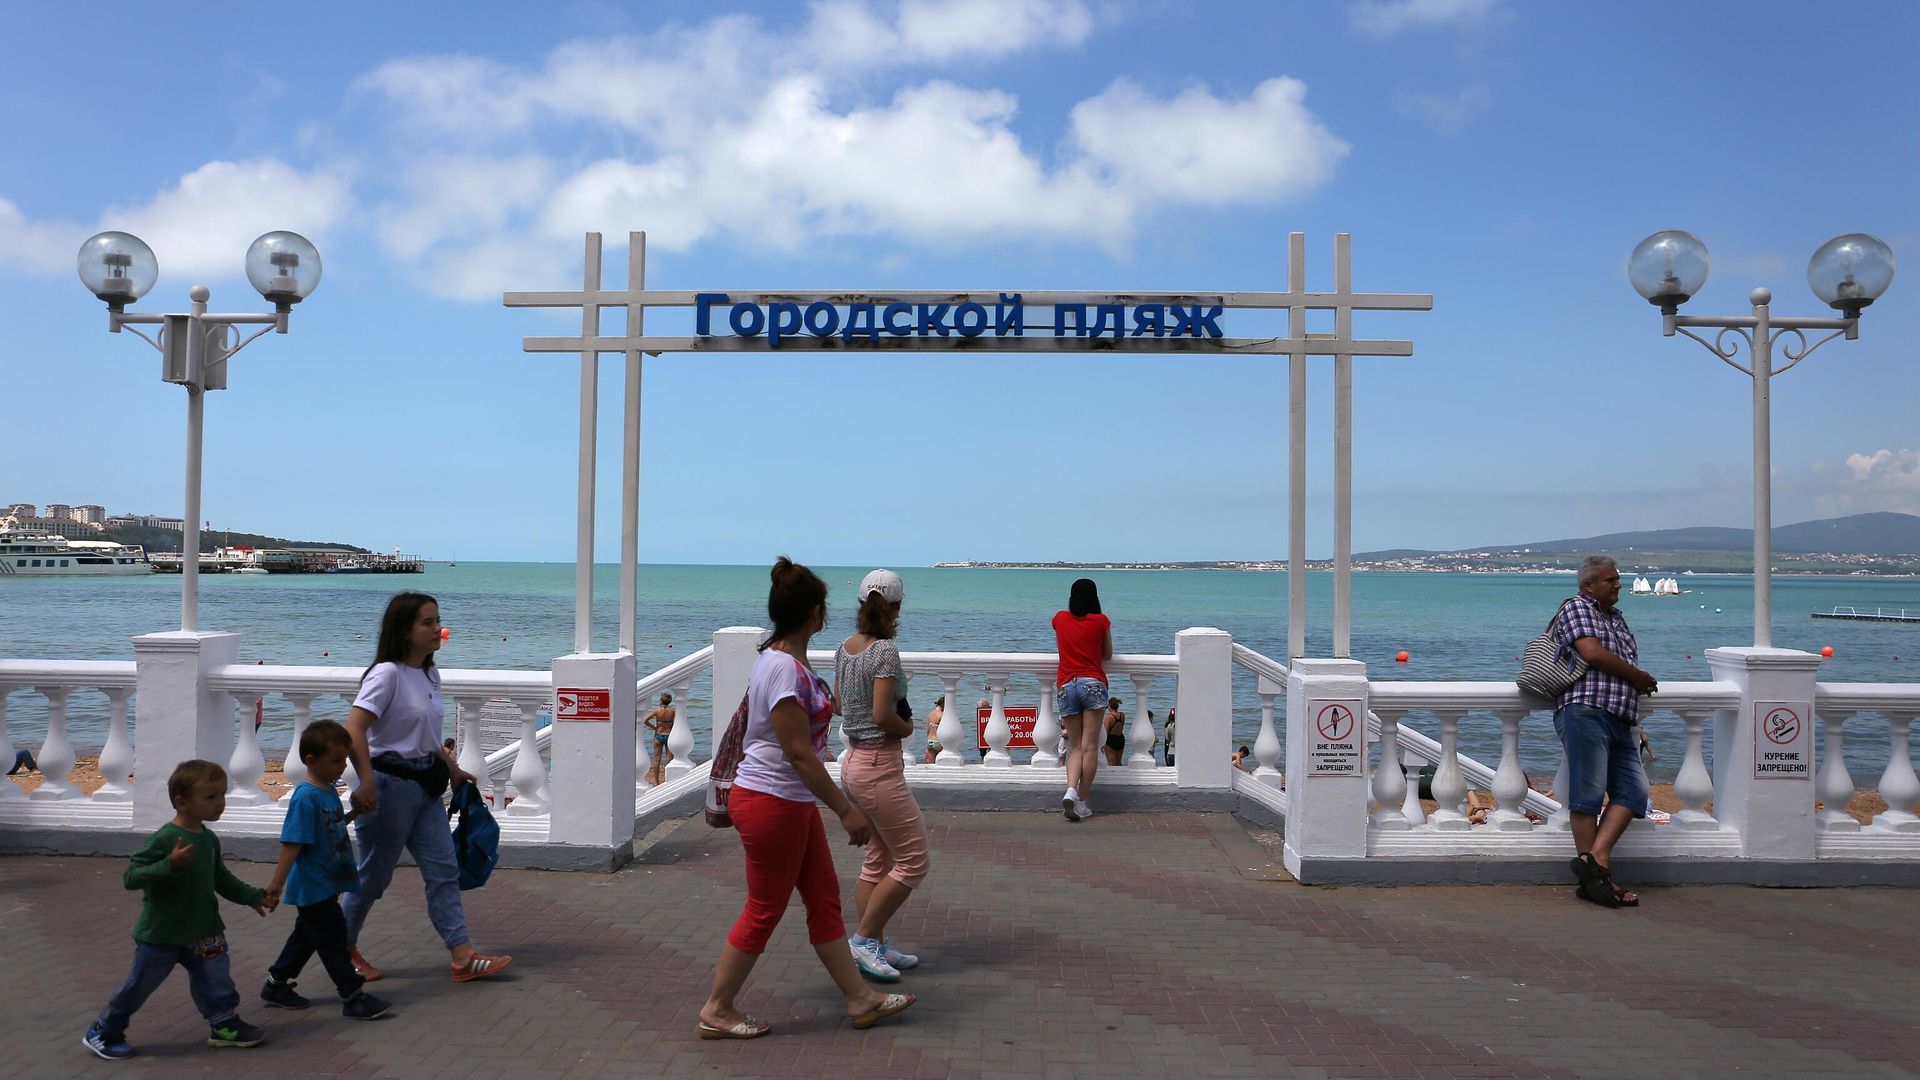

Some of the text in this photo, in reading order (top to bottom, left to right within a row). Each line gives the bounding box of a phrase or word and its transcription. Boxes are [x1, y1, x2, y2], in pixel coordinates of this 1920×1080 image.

[695, 293, 1023, 347] Городской
[1764, 752, 1800, 761] КУРЕНИЕ
[1757, 763, 1807, 773] ЗАПРЕЩЕНО!
